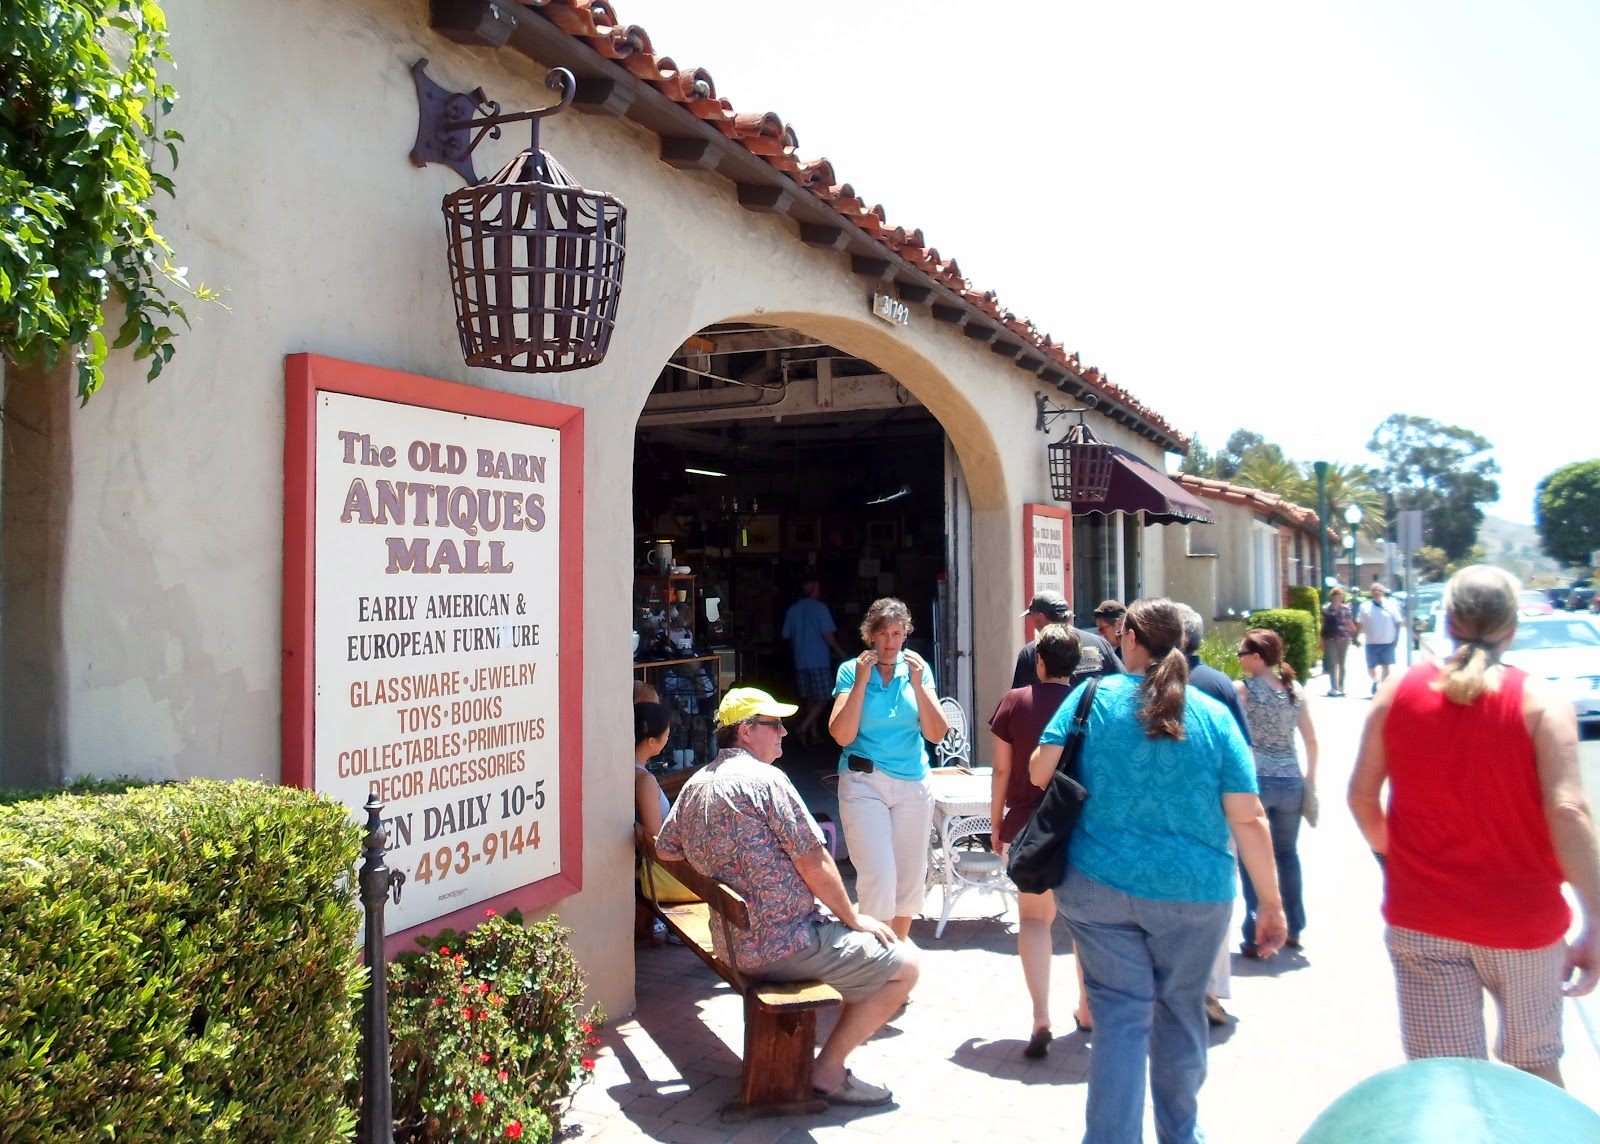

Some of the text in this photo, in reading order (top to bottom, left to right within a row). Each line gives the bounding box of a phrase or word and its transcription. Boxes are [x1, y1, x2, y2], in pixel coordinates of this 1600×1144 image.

[338, 430, 546, 483] The OLD BARN
[340, 477, 546, 536] ANTIQUES
[385, 537, 514, 574] MALL
[1039, 562, 1057, 575] MALL
[358, 592, 527, 623] EARLY AMERICAN &
[347, 624, 540, 661] EUROPEAN FURNIURE
[350, 662, 537, 708] GLASSWARE JEWELRY
[397, 695, 502, 734] TOYS BOOKS
[338, 717, 545, 778] COLLECTABLES PRIMITIVES
[369, 749, 526, 803] DECOR ACCESSORIES
[380, 779, 546, 852] EN DAILY 10-5
[414, 820, 541, 885] 493-9144
